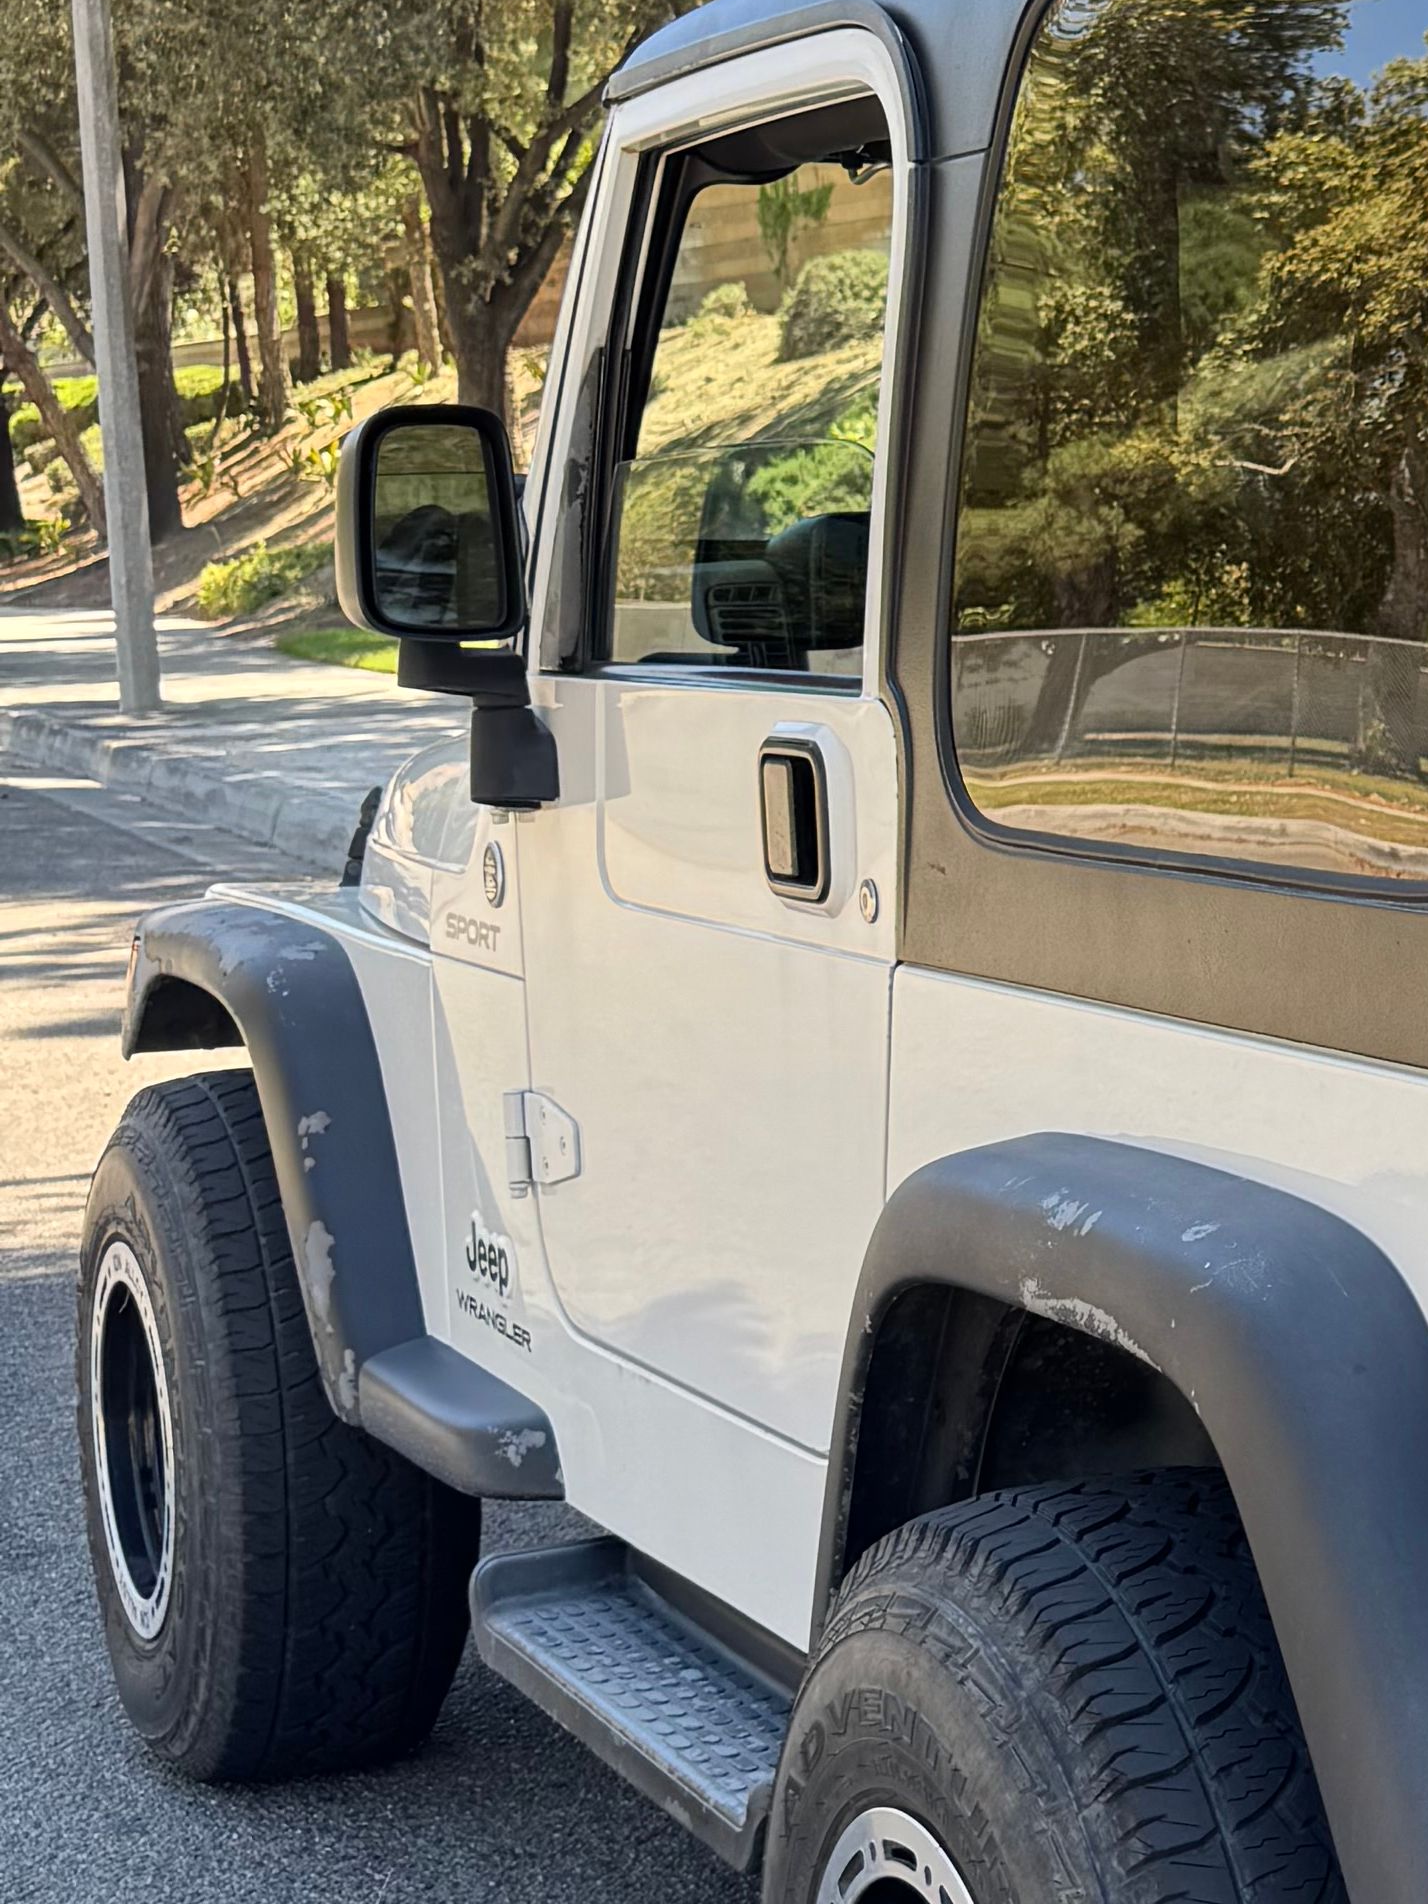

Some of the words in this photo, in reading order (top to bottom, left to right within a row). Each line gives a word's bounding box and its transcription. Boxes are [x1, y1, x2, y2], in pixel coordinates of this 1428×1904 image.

[445, 911, 501, 952] SPORT
[466, 1220, 509, 1297] Jeep
[456, 1287, 532, 1353] WRANGLER
